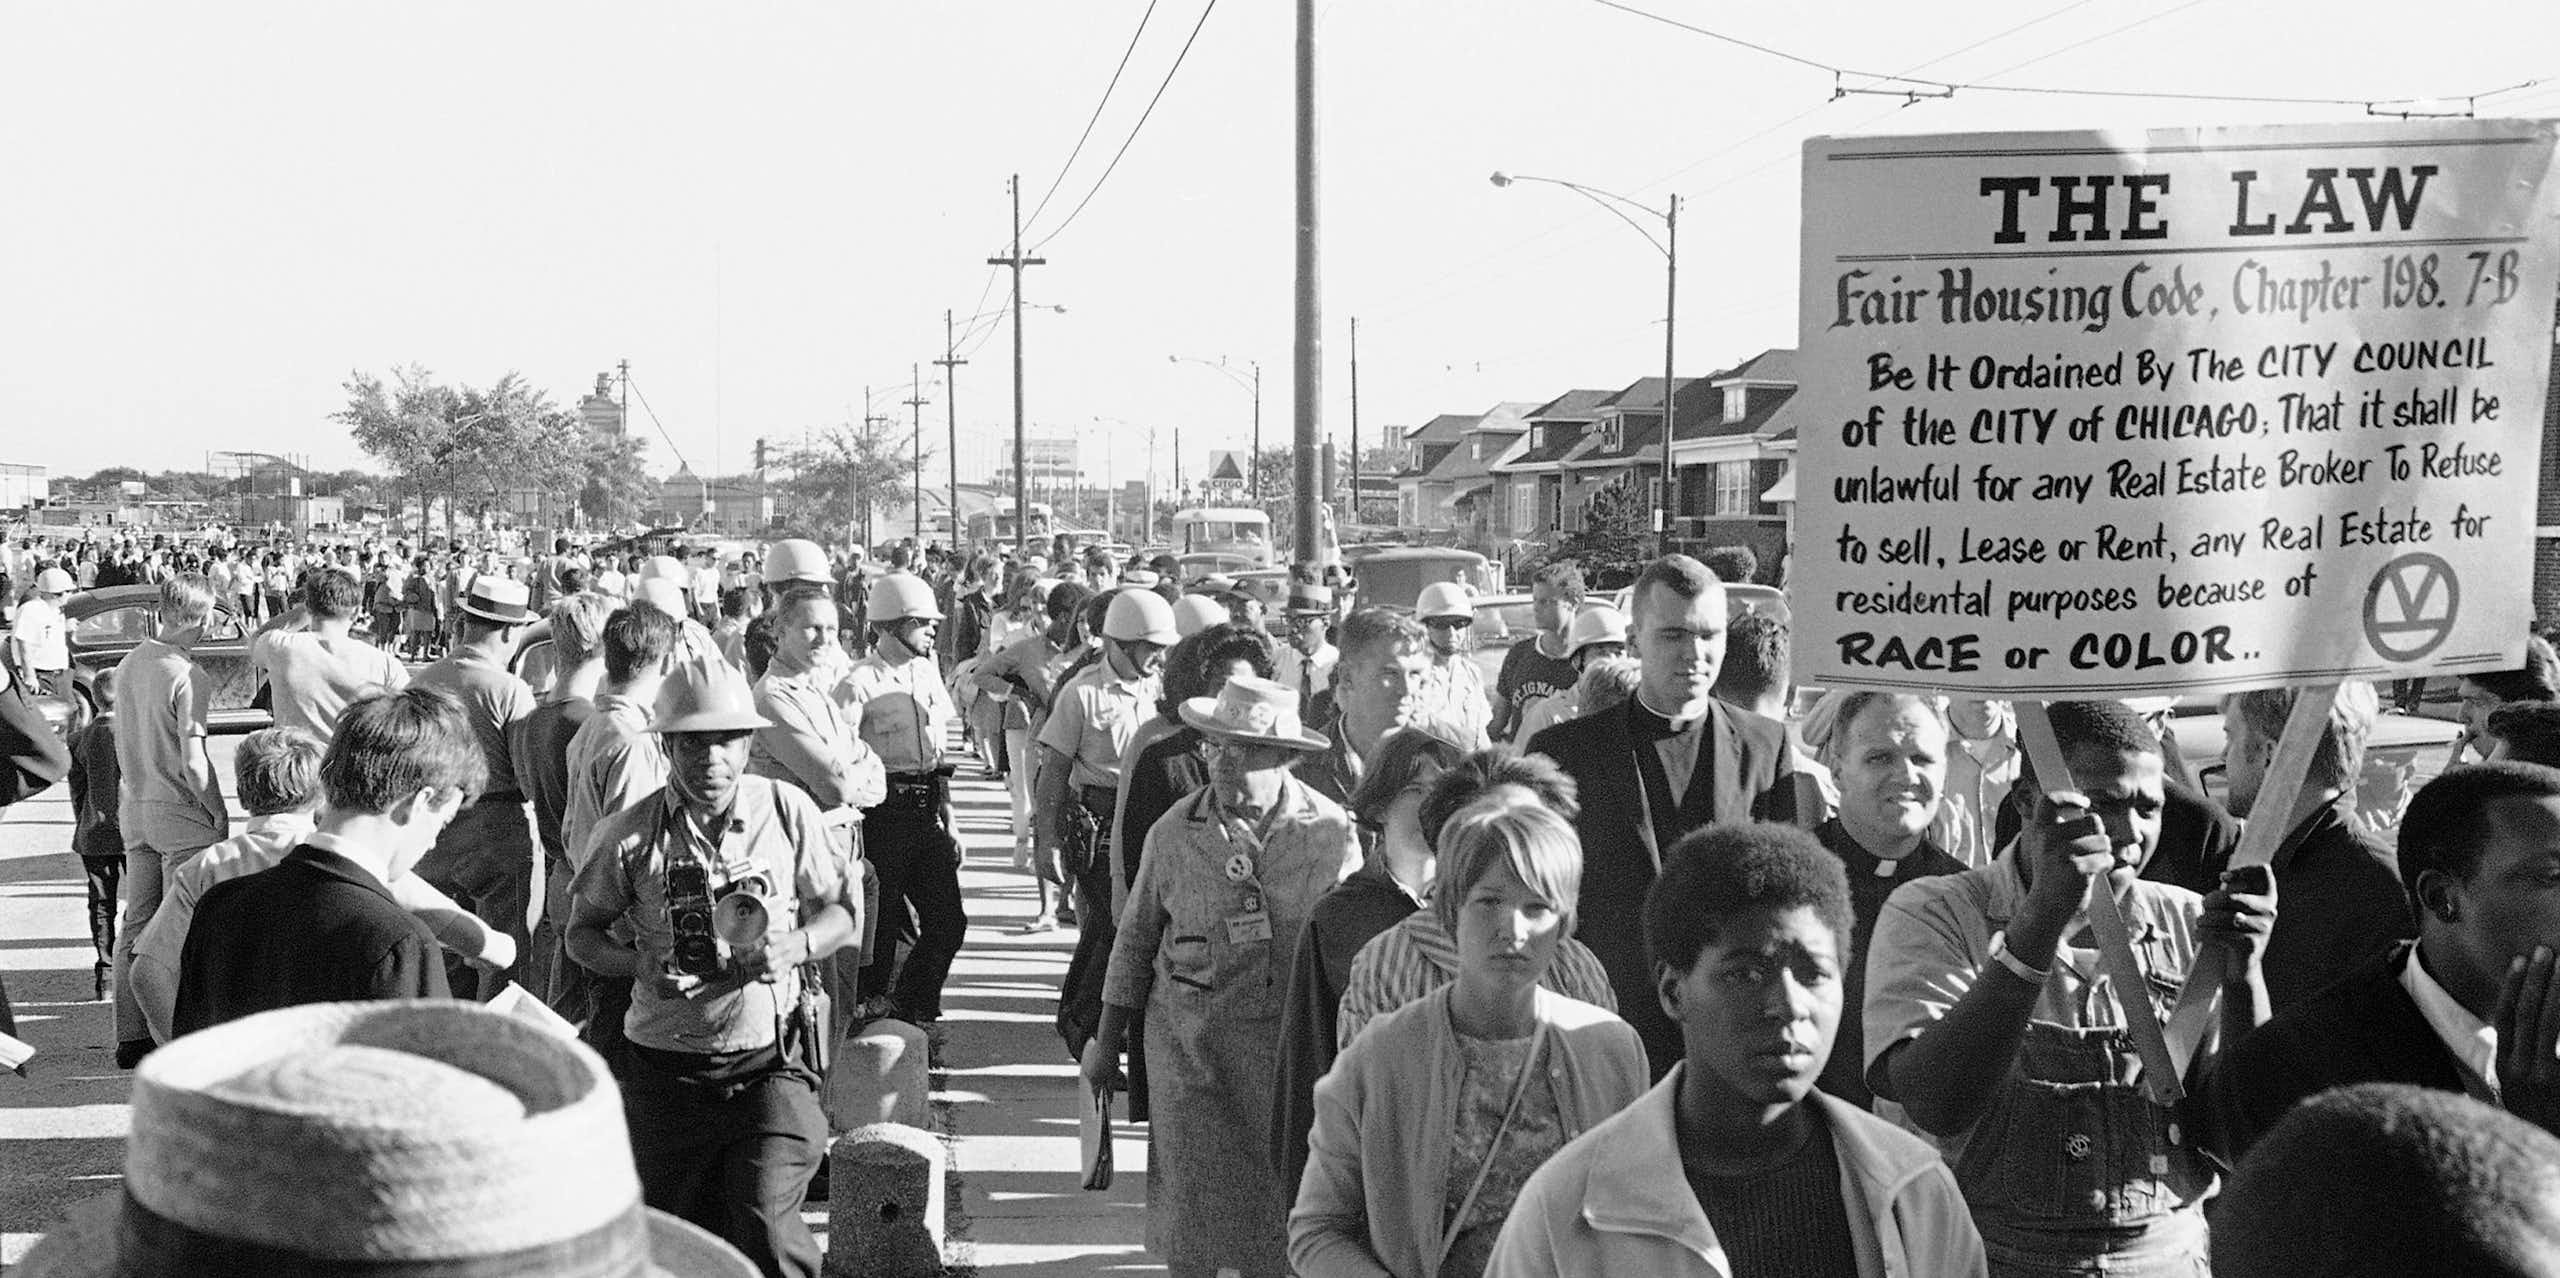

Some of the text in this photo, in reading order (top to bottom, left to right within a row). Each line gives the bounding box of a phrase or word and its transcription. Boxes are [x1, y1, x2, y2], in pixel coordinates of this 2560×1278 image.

[1980, 165, 2439, 245] THE LAW
[1826, 269, 1930, 333] Fair
[1937, 267, 2113, 333] Housing
[2233, 258, 2373, 324] Chapter
[2382, 252, 2446, 309] 198.
[2465, 249, 2520, 308] 7-B
[1867, 336, 2494, 392] Be It Ordained By The CITY COUNCIL
[1842, 405, 1886, 448] of
[1903, 406, 1957, 446] the
[1970, 407, 2058, 445] CITY
[2069, 405, 2105, 443] of
[2278, 391, 2345, 434] That
[2360, 388, 2384, 429] it
[2392, 386, 2458, 428] shall
[2472, 387, 2500, 423] be
[1834, 442, 2503, 504] unlawful for any Real Estate Broker To Refuse
[1836, 502, 2492, 569] to sell, Lease or Rent, any Real Estate for
[2008, 587, 2138, 622] purposes
[2157, 574, 2265, 609] because
[2284, 562, 2318, 598] of
[1835, 631, 1982, 673] RACE
[2005, 647, 2050, 670] or
